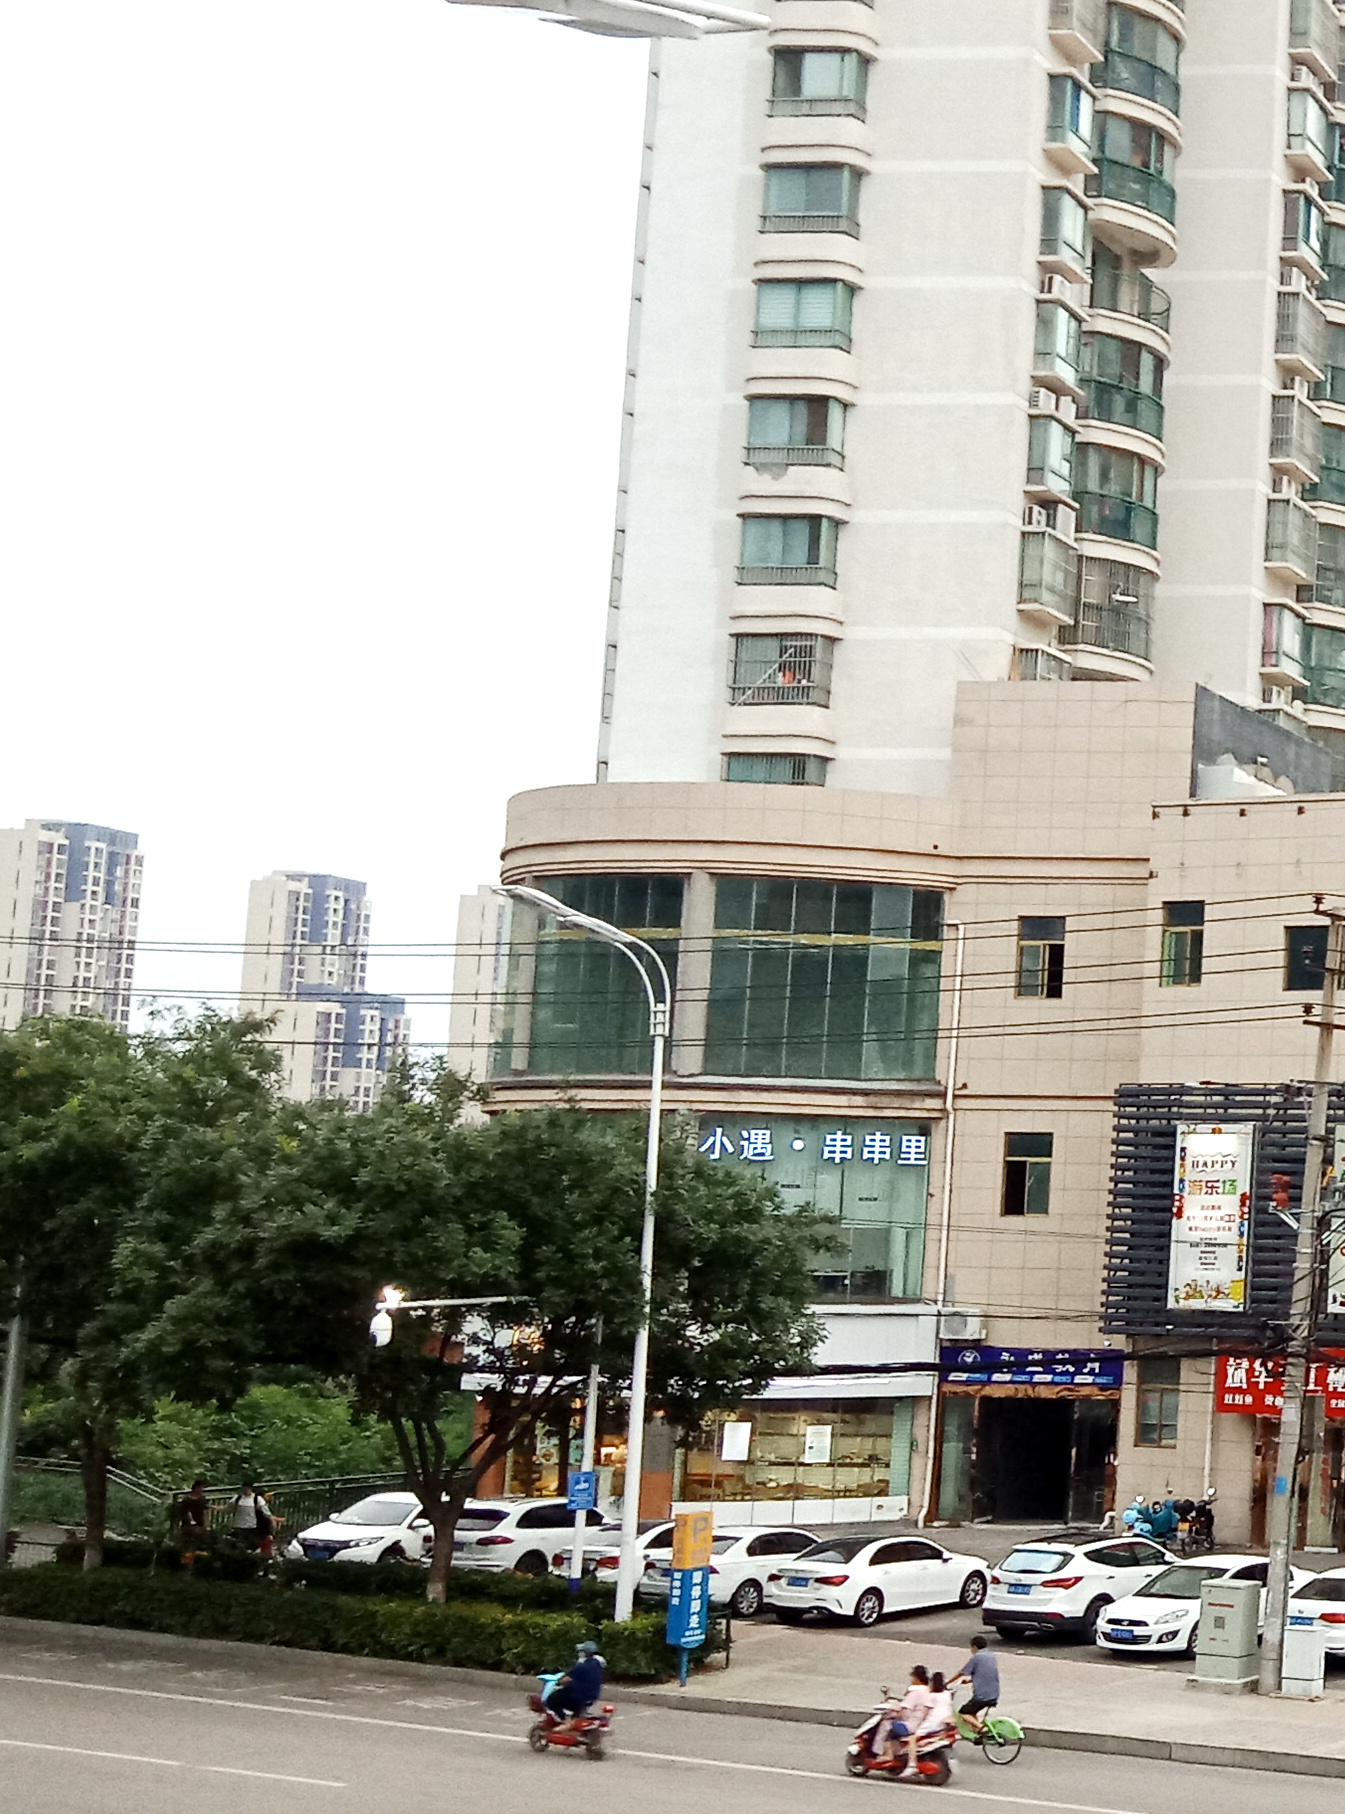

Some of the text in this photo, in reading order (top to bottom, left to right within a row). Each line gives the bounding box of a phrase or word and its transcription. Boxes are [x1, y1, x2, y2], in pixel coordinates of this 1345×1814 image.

[1192, 1160, 1237, 1169] HAPPY
[1188, 1179, 1237, 1195] 游乐场
